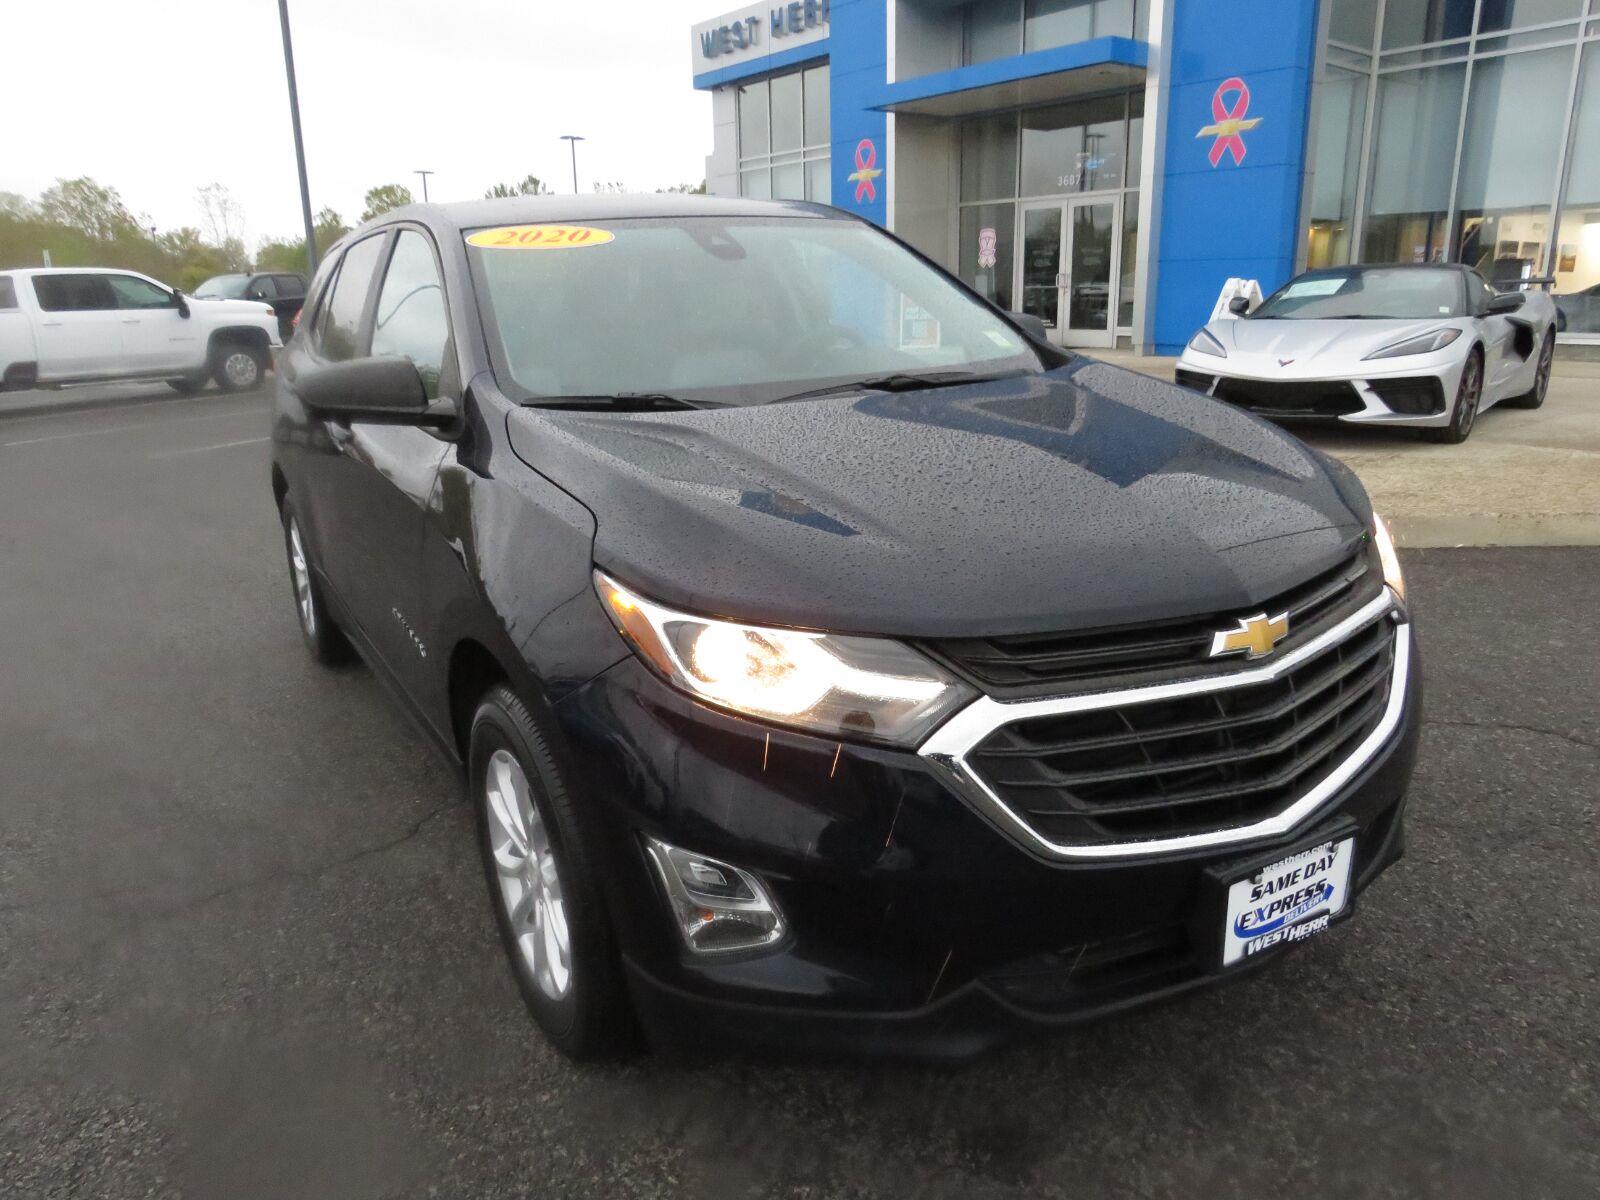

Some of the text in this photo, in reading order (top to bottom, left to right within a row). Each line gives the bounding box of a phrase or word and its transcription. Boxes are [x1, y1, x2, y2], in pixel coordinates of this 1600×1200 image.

[700, 16, 759, 58] WEST
[493, 229, 591, 245] 2020
[1250, 851, 1337, 903] SAME DAY
[1239, 878, 1328, 930] EXPRESS
